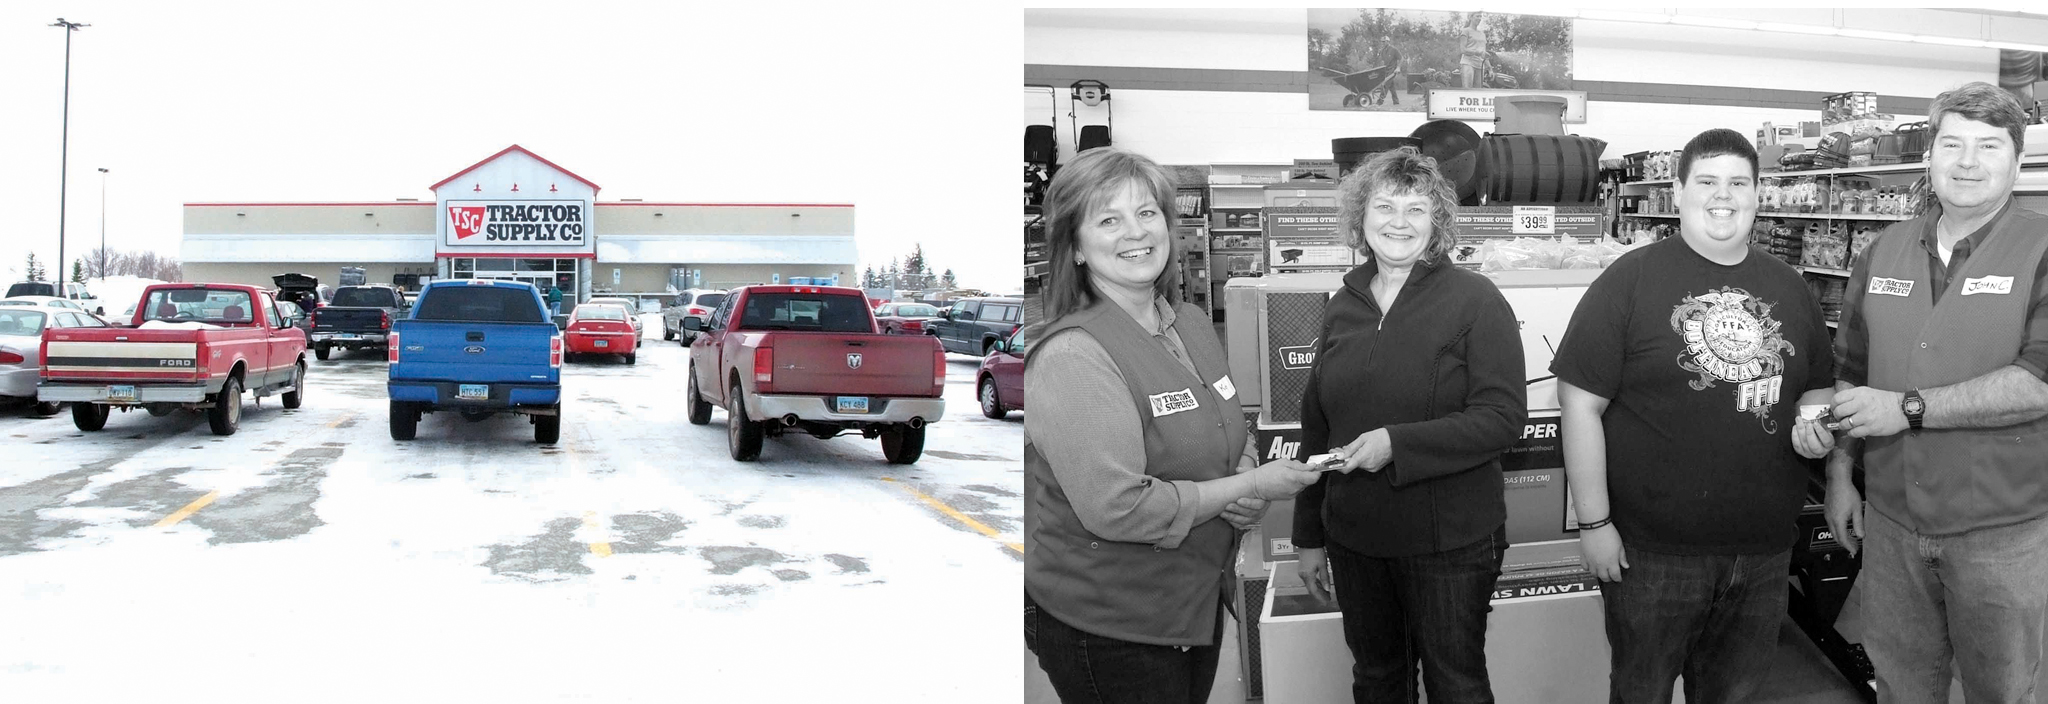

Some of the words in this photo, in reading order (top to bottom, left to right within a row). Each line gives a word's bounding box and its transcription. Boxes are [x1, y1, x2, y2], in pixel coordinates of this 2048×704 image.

[1460, 97, 1479, 106] FOR
[486, 205, 582, 222] TRACTOR
[452, 208, 479, 233] TSC
[486, 223, 558, 241] SUPPLY
[1969, 282, 1997, 291] JOHN
[1722, 322, 1744, 330] FFA
[1683, 320, 1762, 382] BOTTINEAU
[1720, 341, 1752, 352] EDUCATION
[1737, 375, 1782, 412] FFA
[1519, 423, 1557, 439] PER
[1520, 476, 1535, 484] (112
[1818, 532, 1833, 540] OH
[1520, 583, 1584, 596] LAWN
